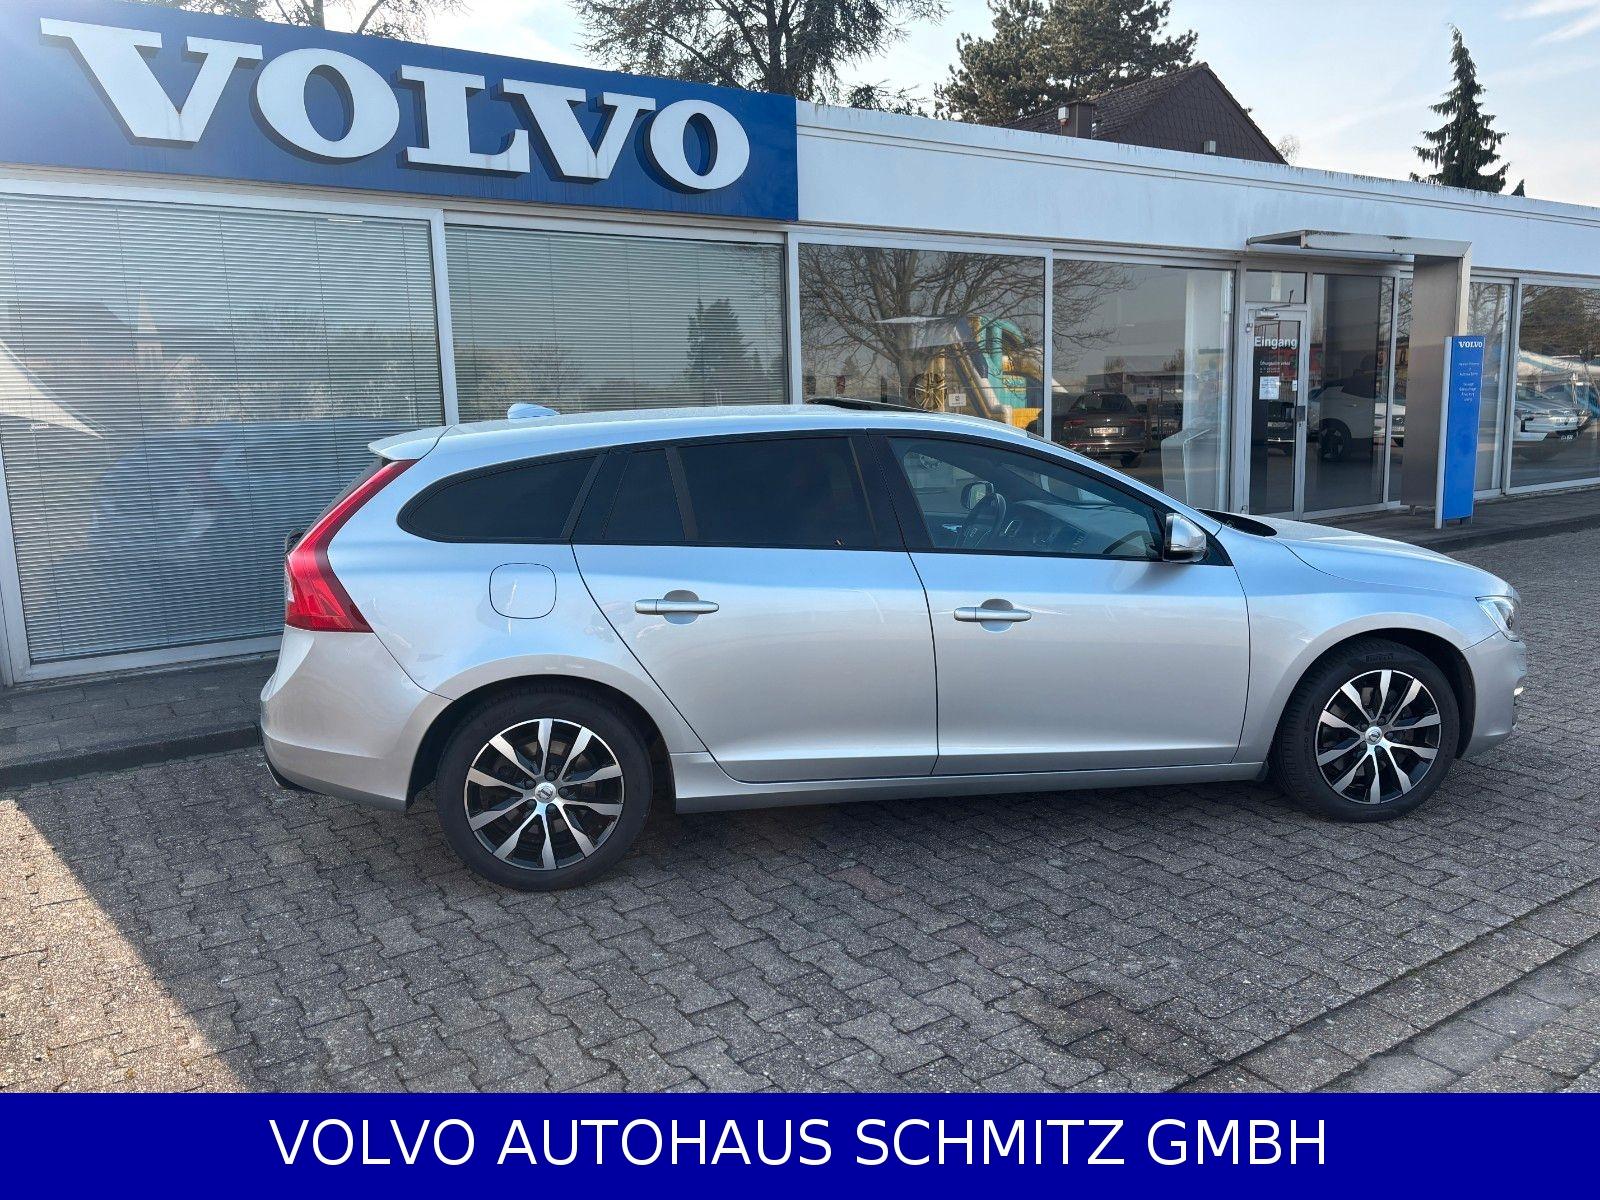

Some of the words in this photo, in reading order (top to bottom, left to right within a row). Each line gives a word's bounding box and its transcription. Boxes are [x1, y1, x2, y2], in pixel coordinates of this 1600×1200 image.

[40, 18, 750, 190] VOLVO
[1254, 336, 1298, 350] Eingang
[1458, 341, 1483, 349] VOLVO
